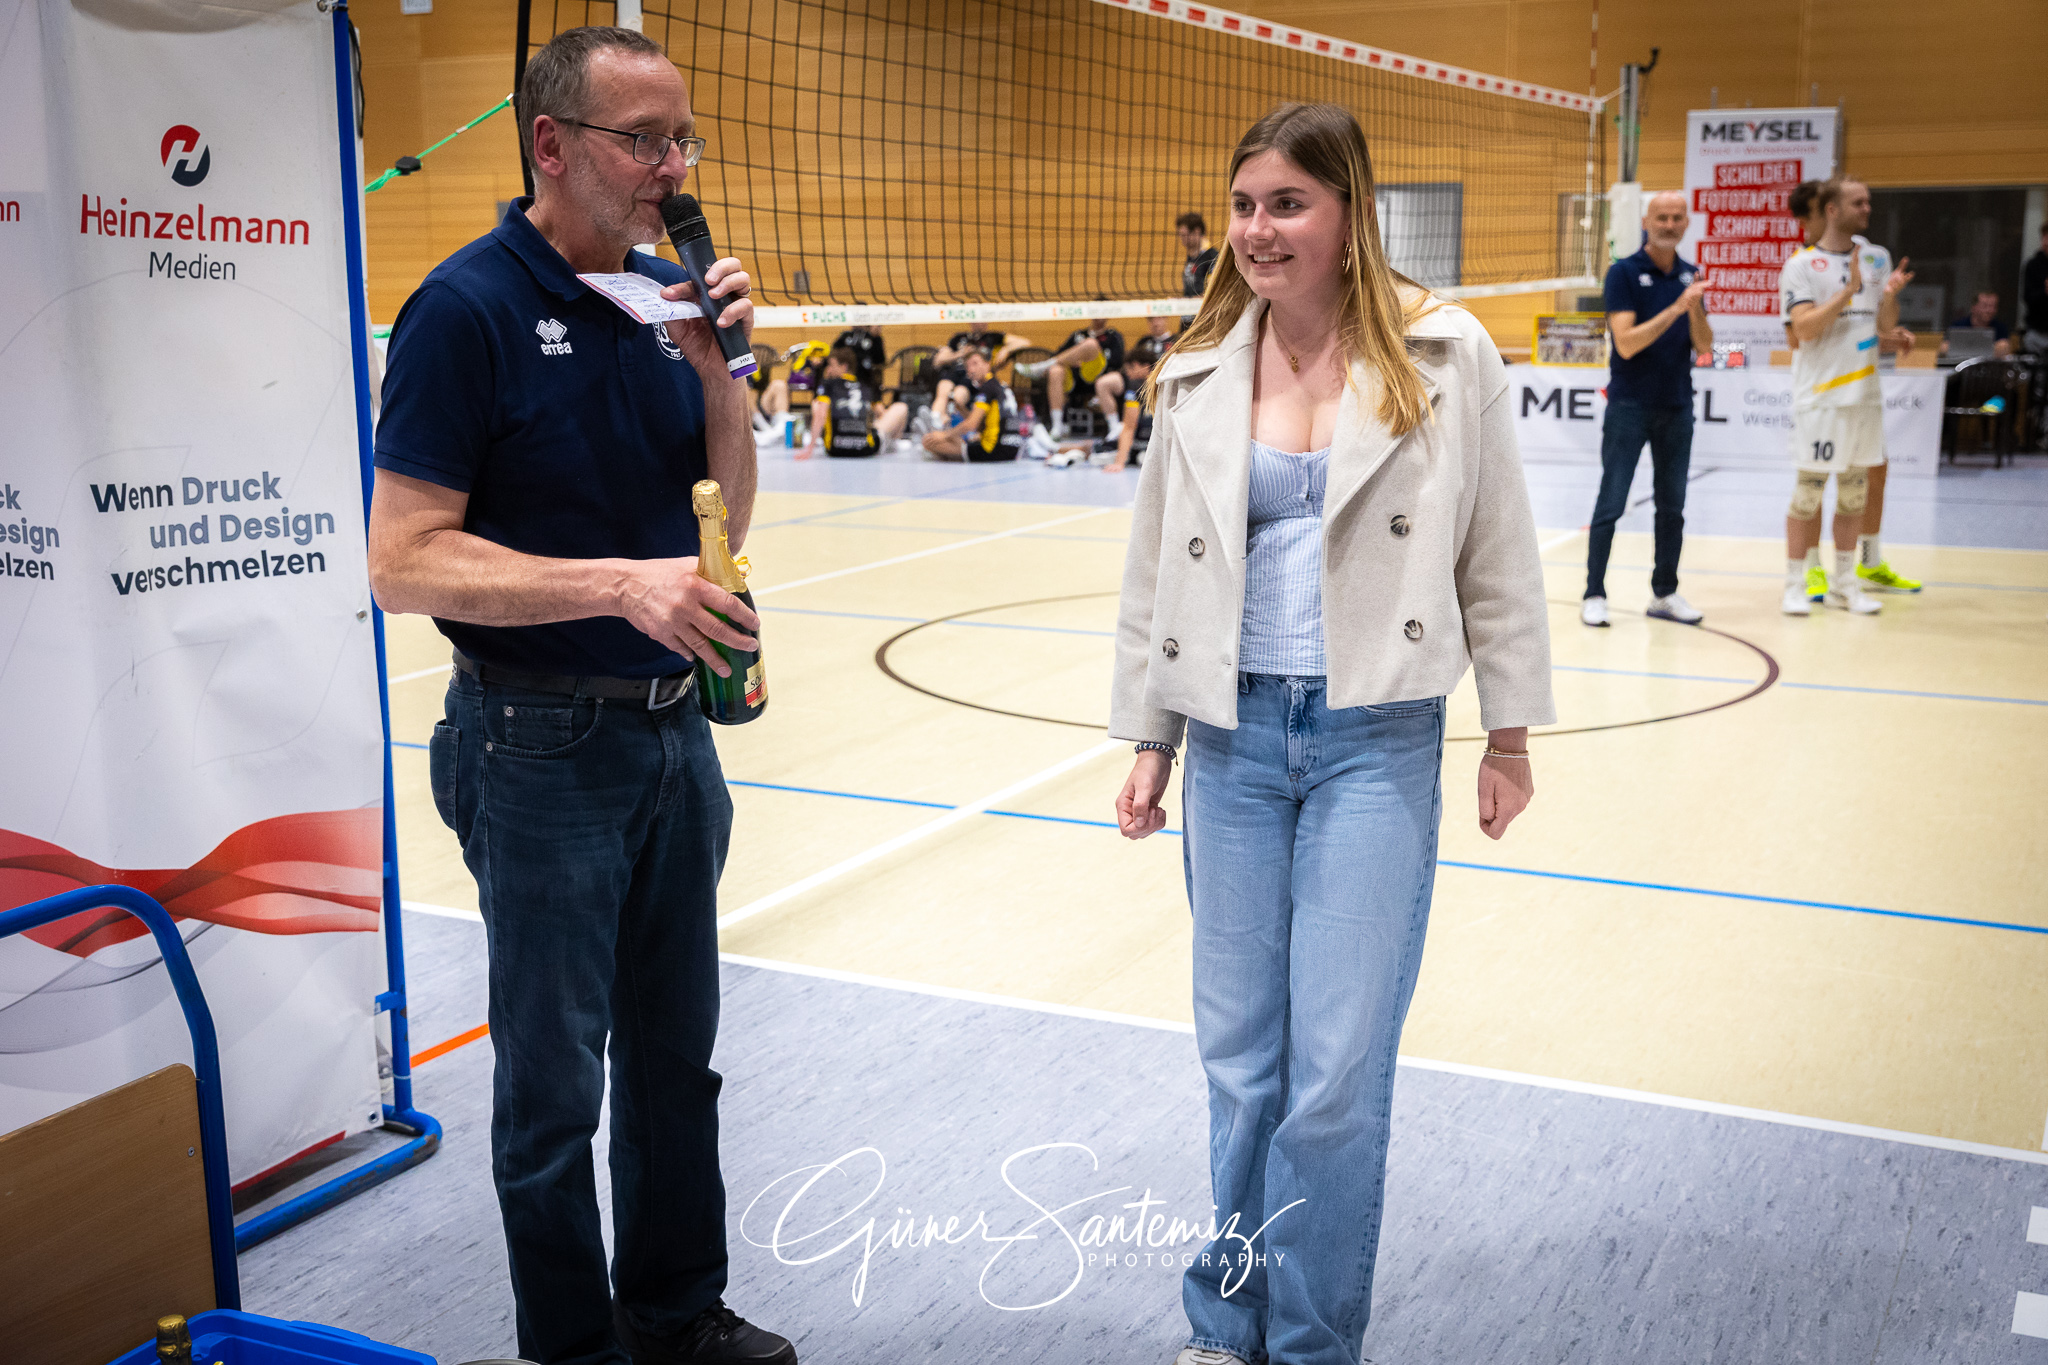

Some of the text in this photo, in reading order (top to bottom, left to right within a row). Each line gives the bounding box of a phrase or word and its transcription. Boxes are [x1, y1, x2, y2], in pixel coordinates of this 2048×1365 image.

[1702, 120, 1820, 142] MEYSEL
[1718, 161, 1797, 187] SCHILDER
[1699, 189, 1791, 212] FOTOTAPET
[80, 193, 310, 245] Heinzelmann
[1712, 214, 1800, 238] SCHRIFTEN
[149, 251, 236, 280] Medien
[1708, 267, 1779, 290] FAHRZEU
[540, 341, 573, 355] errea
[1812, 440, 1834, 461] 10
[90, 471, 282, 513] Wenn Druck
[150, 507, 335, 549] und Design
[111, 550, 326, 596] verschmelzen
